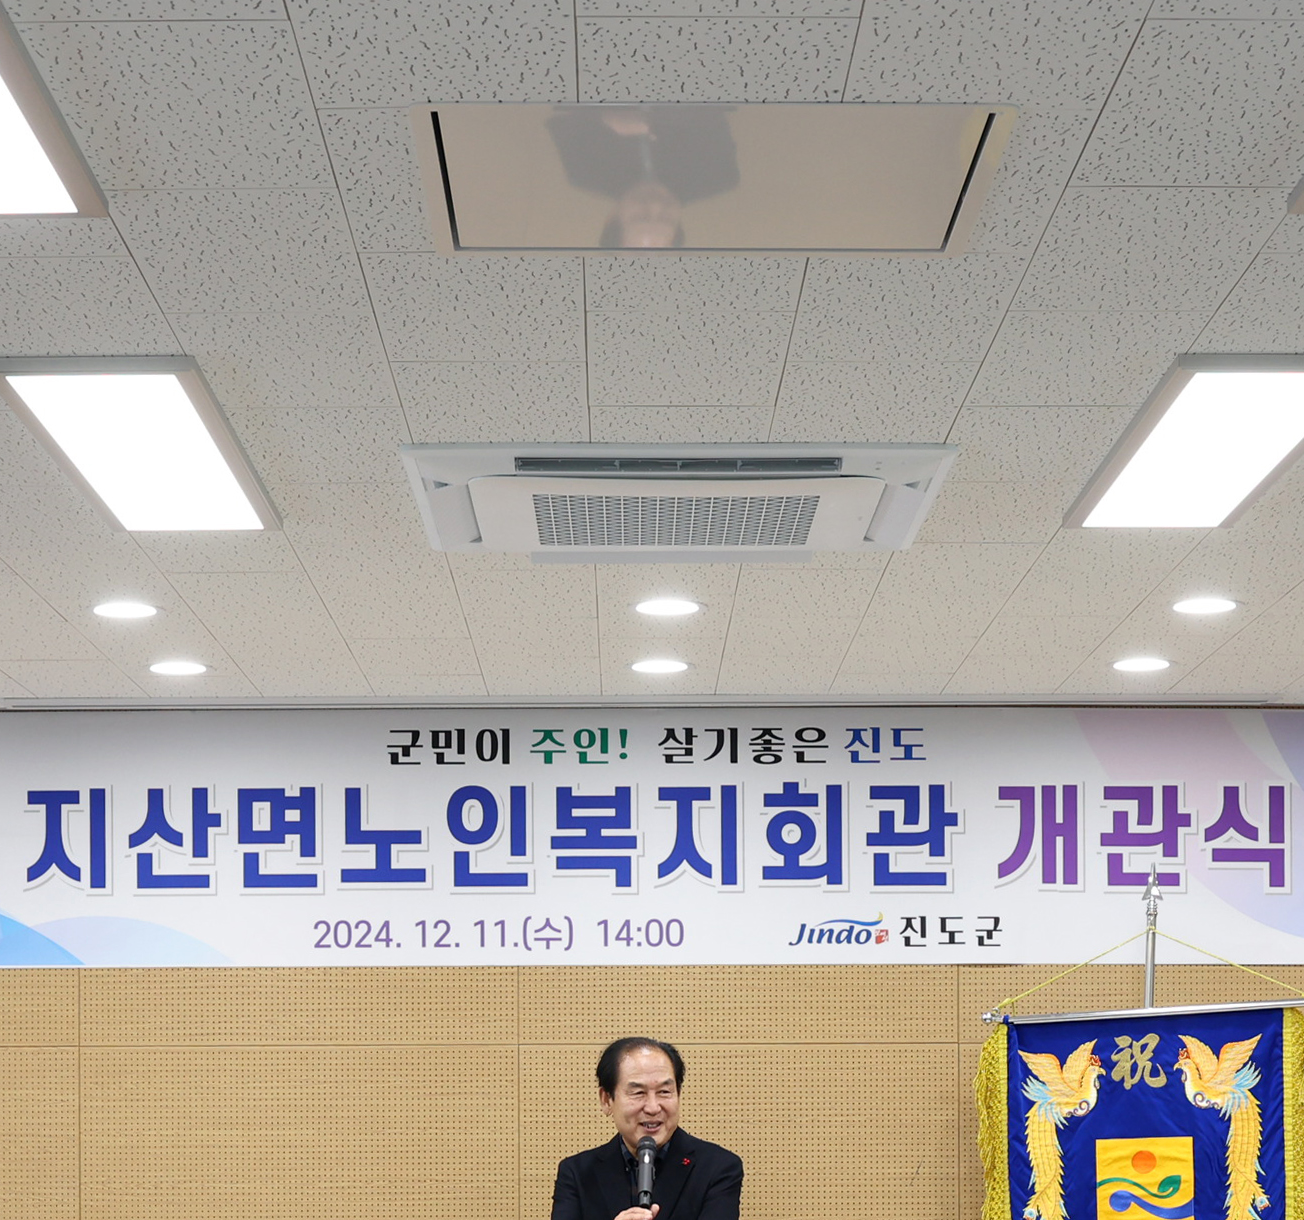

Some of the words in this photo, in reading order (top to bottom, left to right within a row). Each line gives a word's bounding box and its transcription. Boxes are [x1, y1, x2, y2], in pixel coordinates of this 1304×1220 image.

[386, 727, 512, 766] 군민이
[529, 727, 629, 765] 주인!
[657, 726, 830, 765] 살기좋은
[843, 726, 928, 763] 진도
[25, 783, 959, 891] 지산면노인복지회관
[996, 782, 1286, 889] 개관식
[313, 920, 403, 950] 2024.
[414, 920, 460, 949] 12.
[473, 917, 574, 951] 11.(수)
[597, 918, 685, 946] 14:00
[788, 922, 872, 946] Jindo
[899, 915, 1003, 948] 진도군
[1110, 1032, 1168, 1090] 祝
